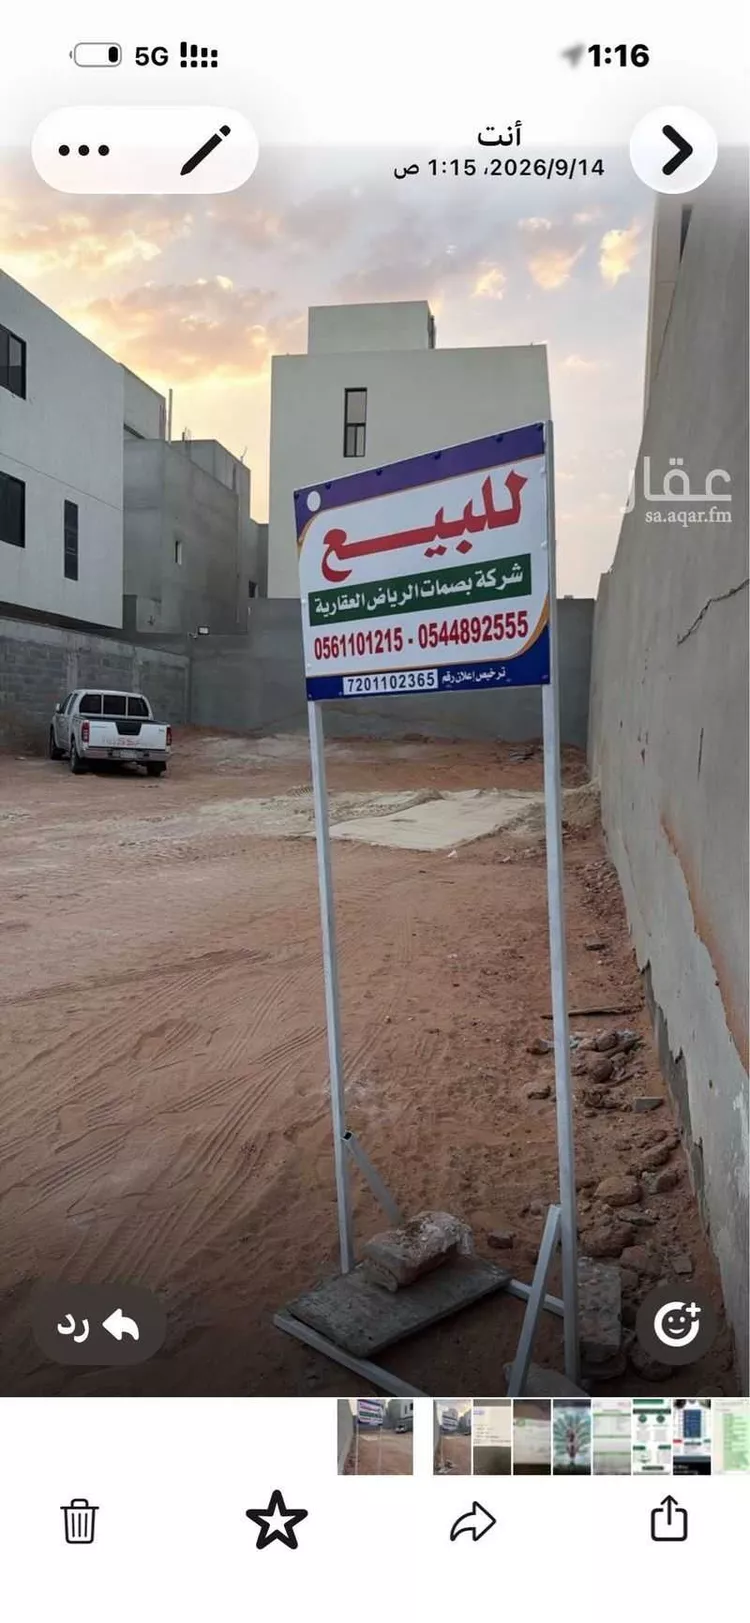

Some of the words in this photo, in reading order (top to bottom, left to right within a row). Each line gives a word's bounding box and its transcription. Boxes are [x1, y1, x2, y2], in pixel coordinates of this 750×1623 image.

[321, 470, 528, 582] للبيع
[475, 562, 523, 589] شركة
[367, 583, 418, 611] الرياض
[423, 579, 472, 597] بصمات
[315, 594, 365, 616] العقارية
[314, 627, 403, 660] 0561101215
[417, 610, 528, 649] 0544892555
[347, 672, 436, 692] 7201102365
[441, 671, 455, 684] رقم
[475, 666, 506, 682] ترخيص
